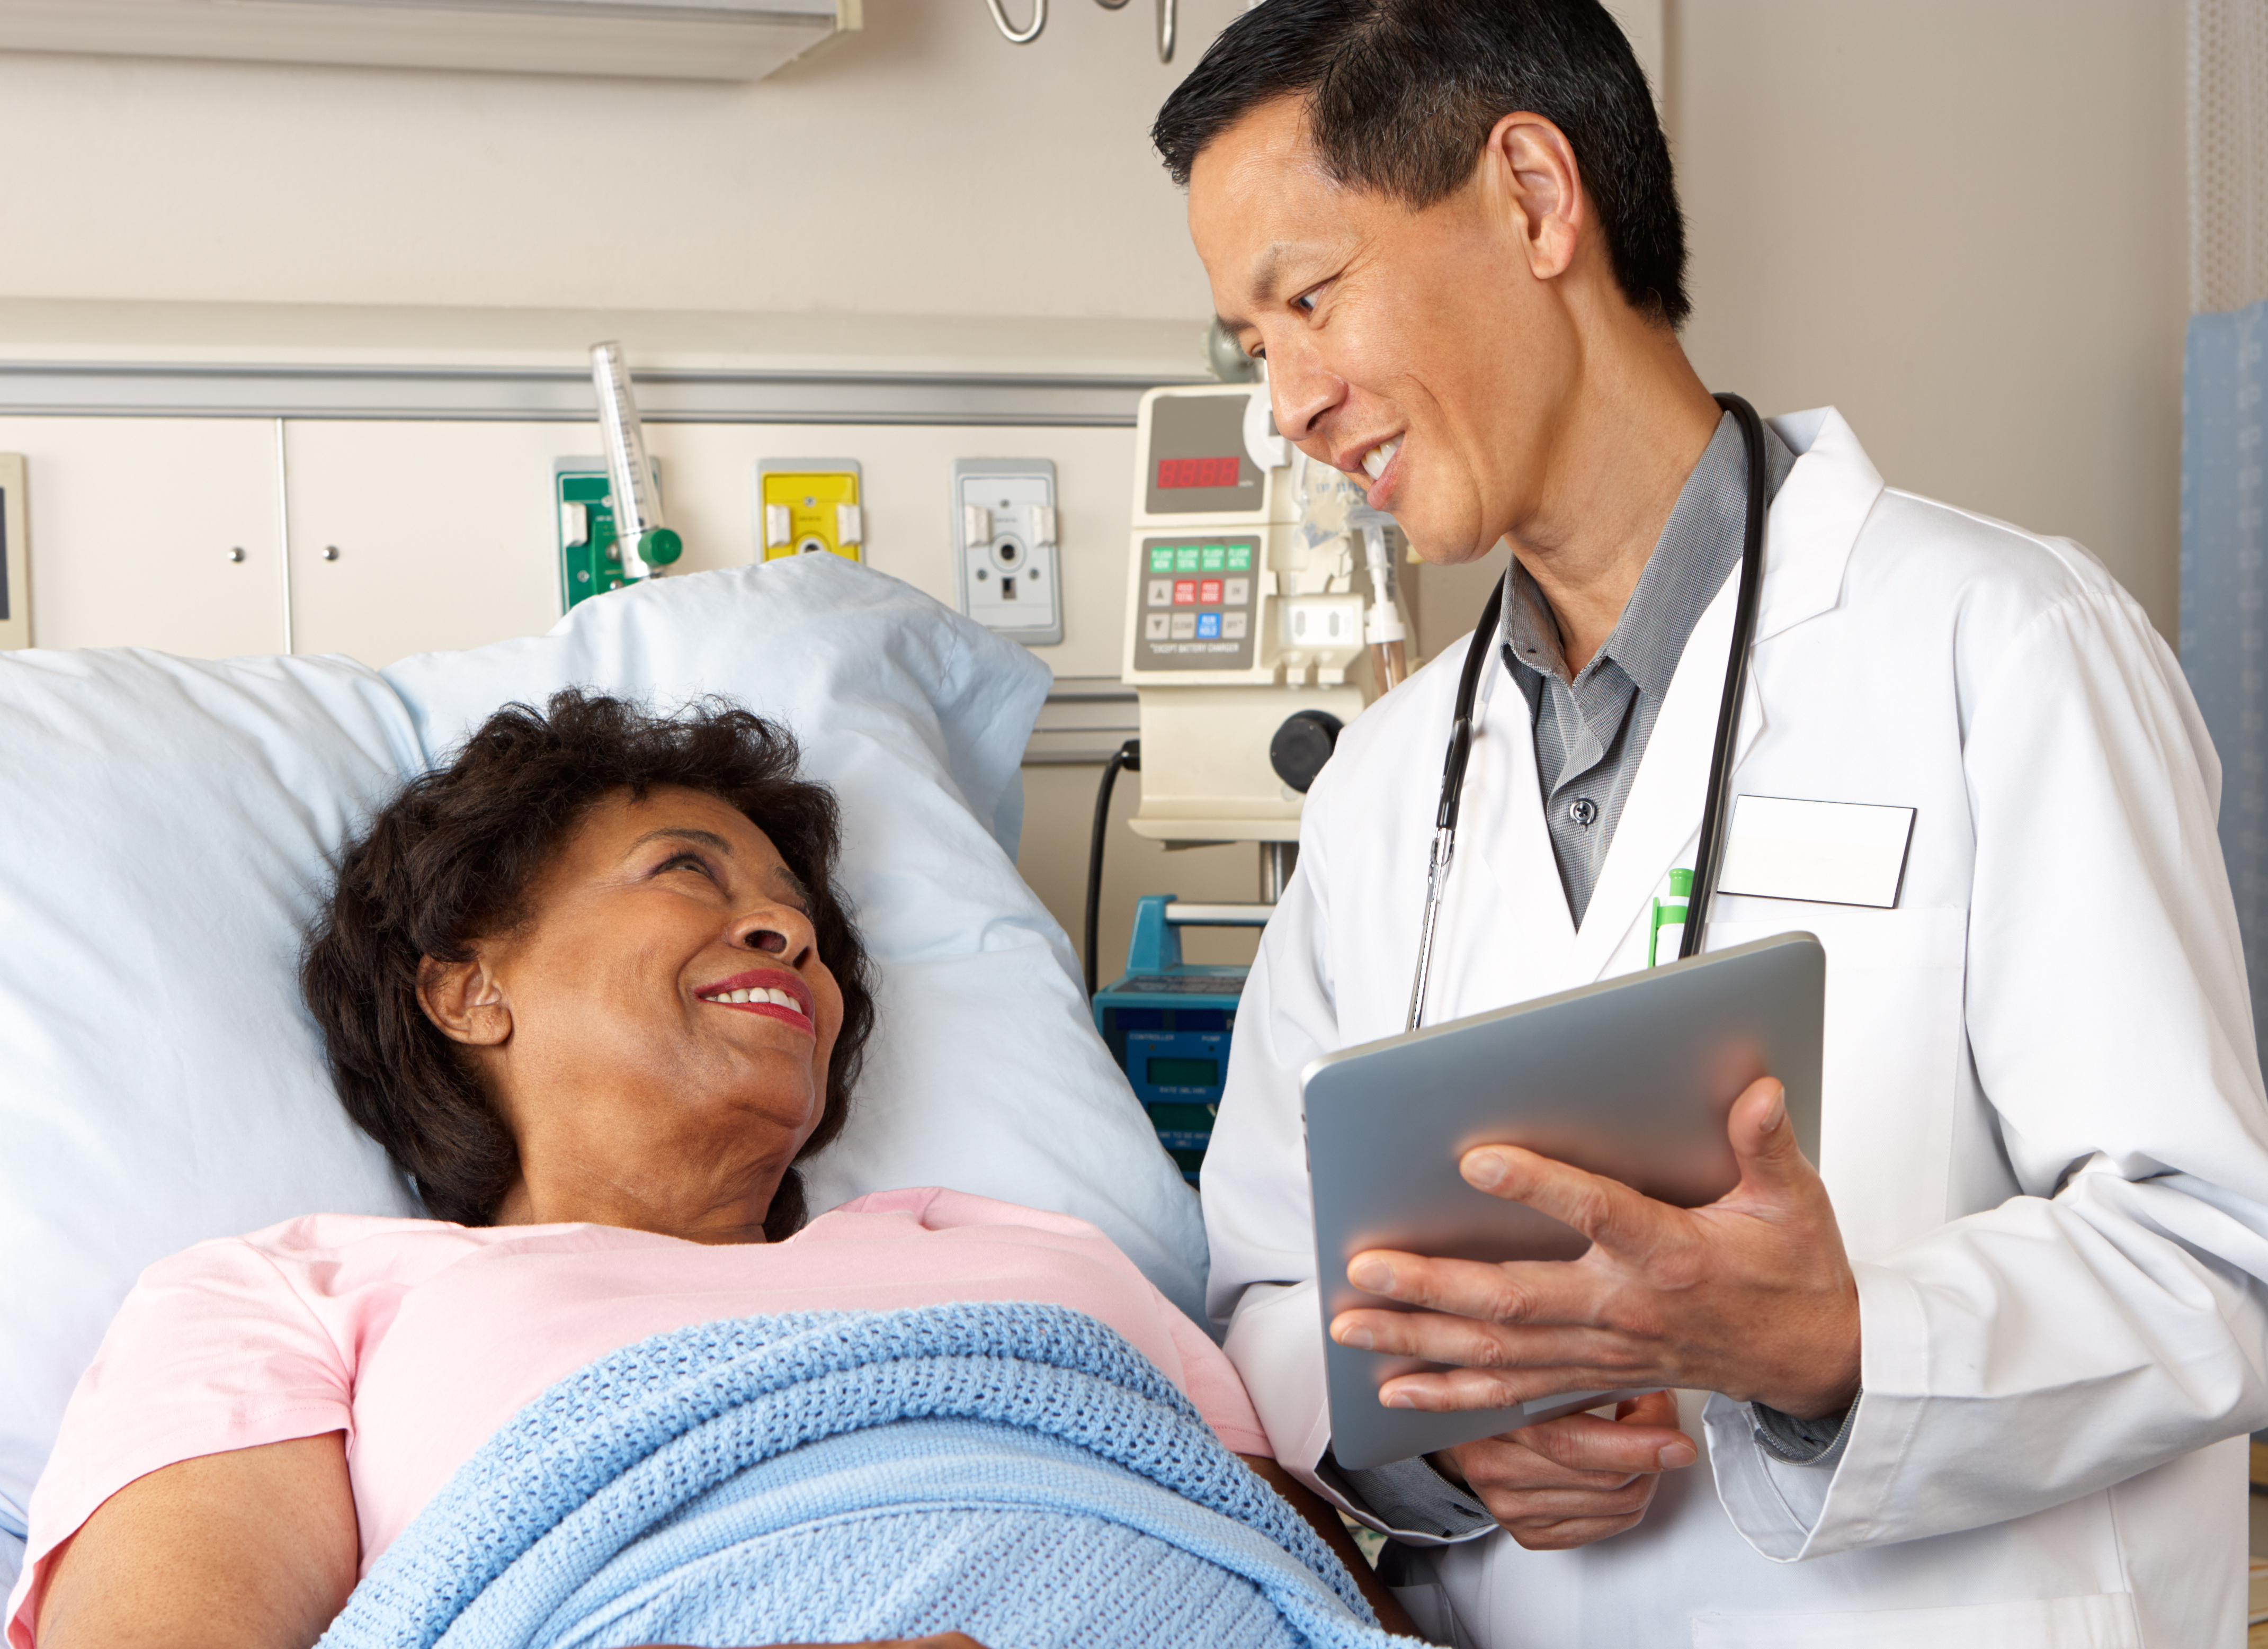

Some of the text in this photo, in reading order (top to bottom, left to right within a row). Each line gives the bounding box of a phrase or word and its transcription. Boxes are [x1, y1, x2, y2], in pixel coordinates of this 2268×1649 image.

[1175, 593, 1194, 602] TOTAL
[1178, 642, 1207, 653] BATTERY
[1207, 642, 1239, 653] CHARGER
[1129, 1033, 1175, 1041] CONTROLLER
